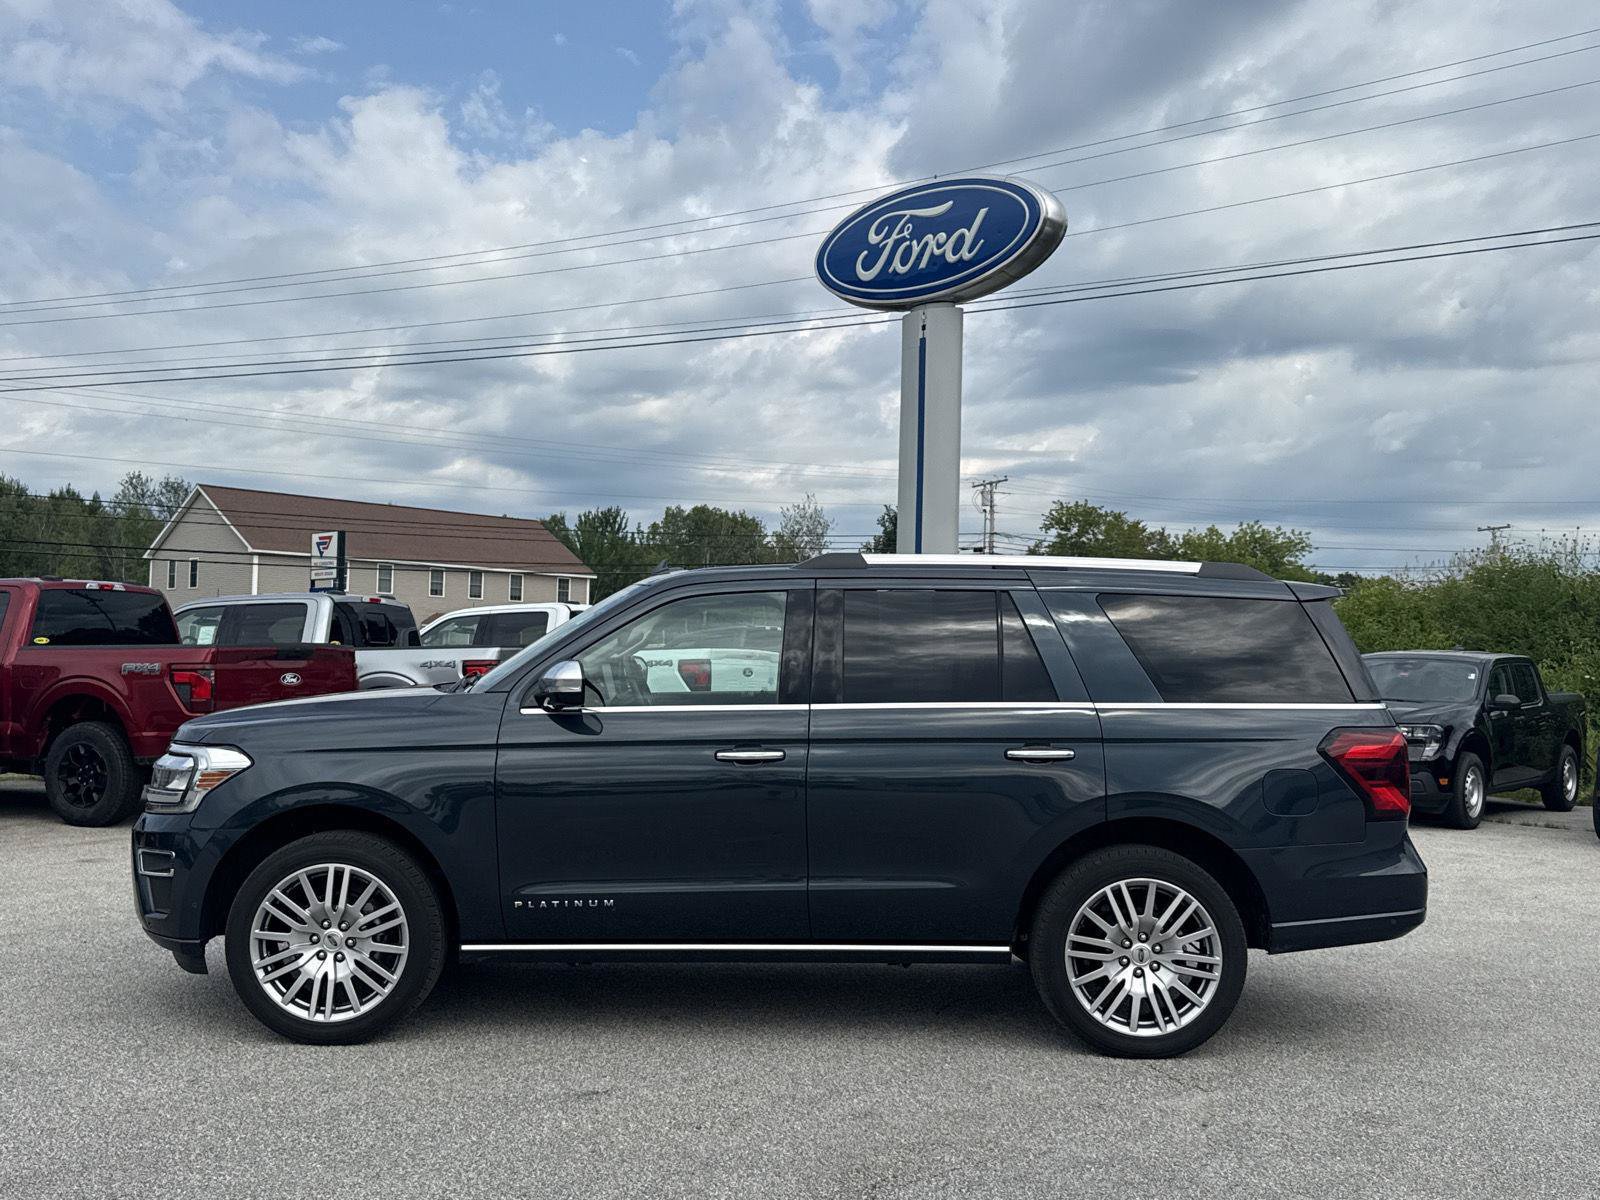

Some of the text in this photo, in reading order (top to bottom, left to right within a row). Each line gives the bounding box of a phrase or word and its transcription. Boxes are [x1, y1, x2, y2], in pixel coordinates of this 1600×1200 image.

[855, 200, 989, 282] Ford
[121, 662, 161, 675] FX4
[514, 899, 614, 908] PLATINUM
